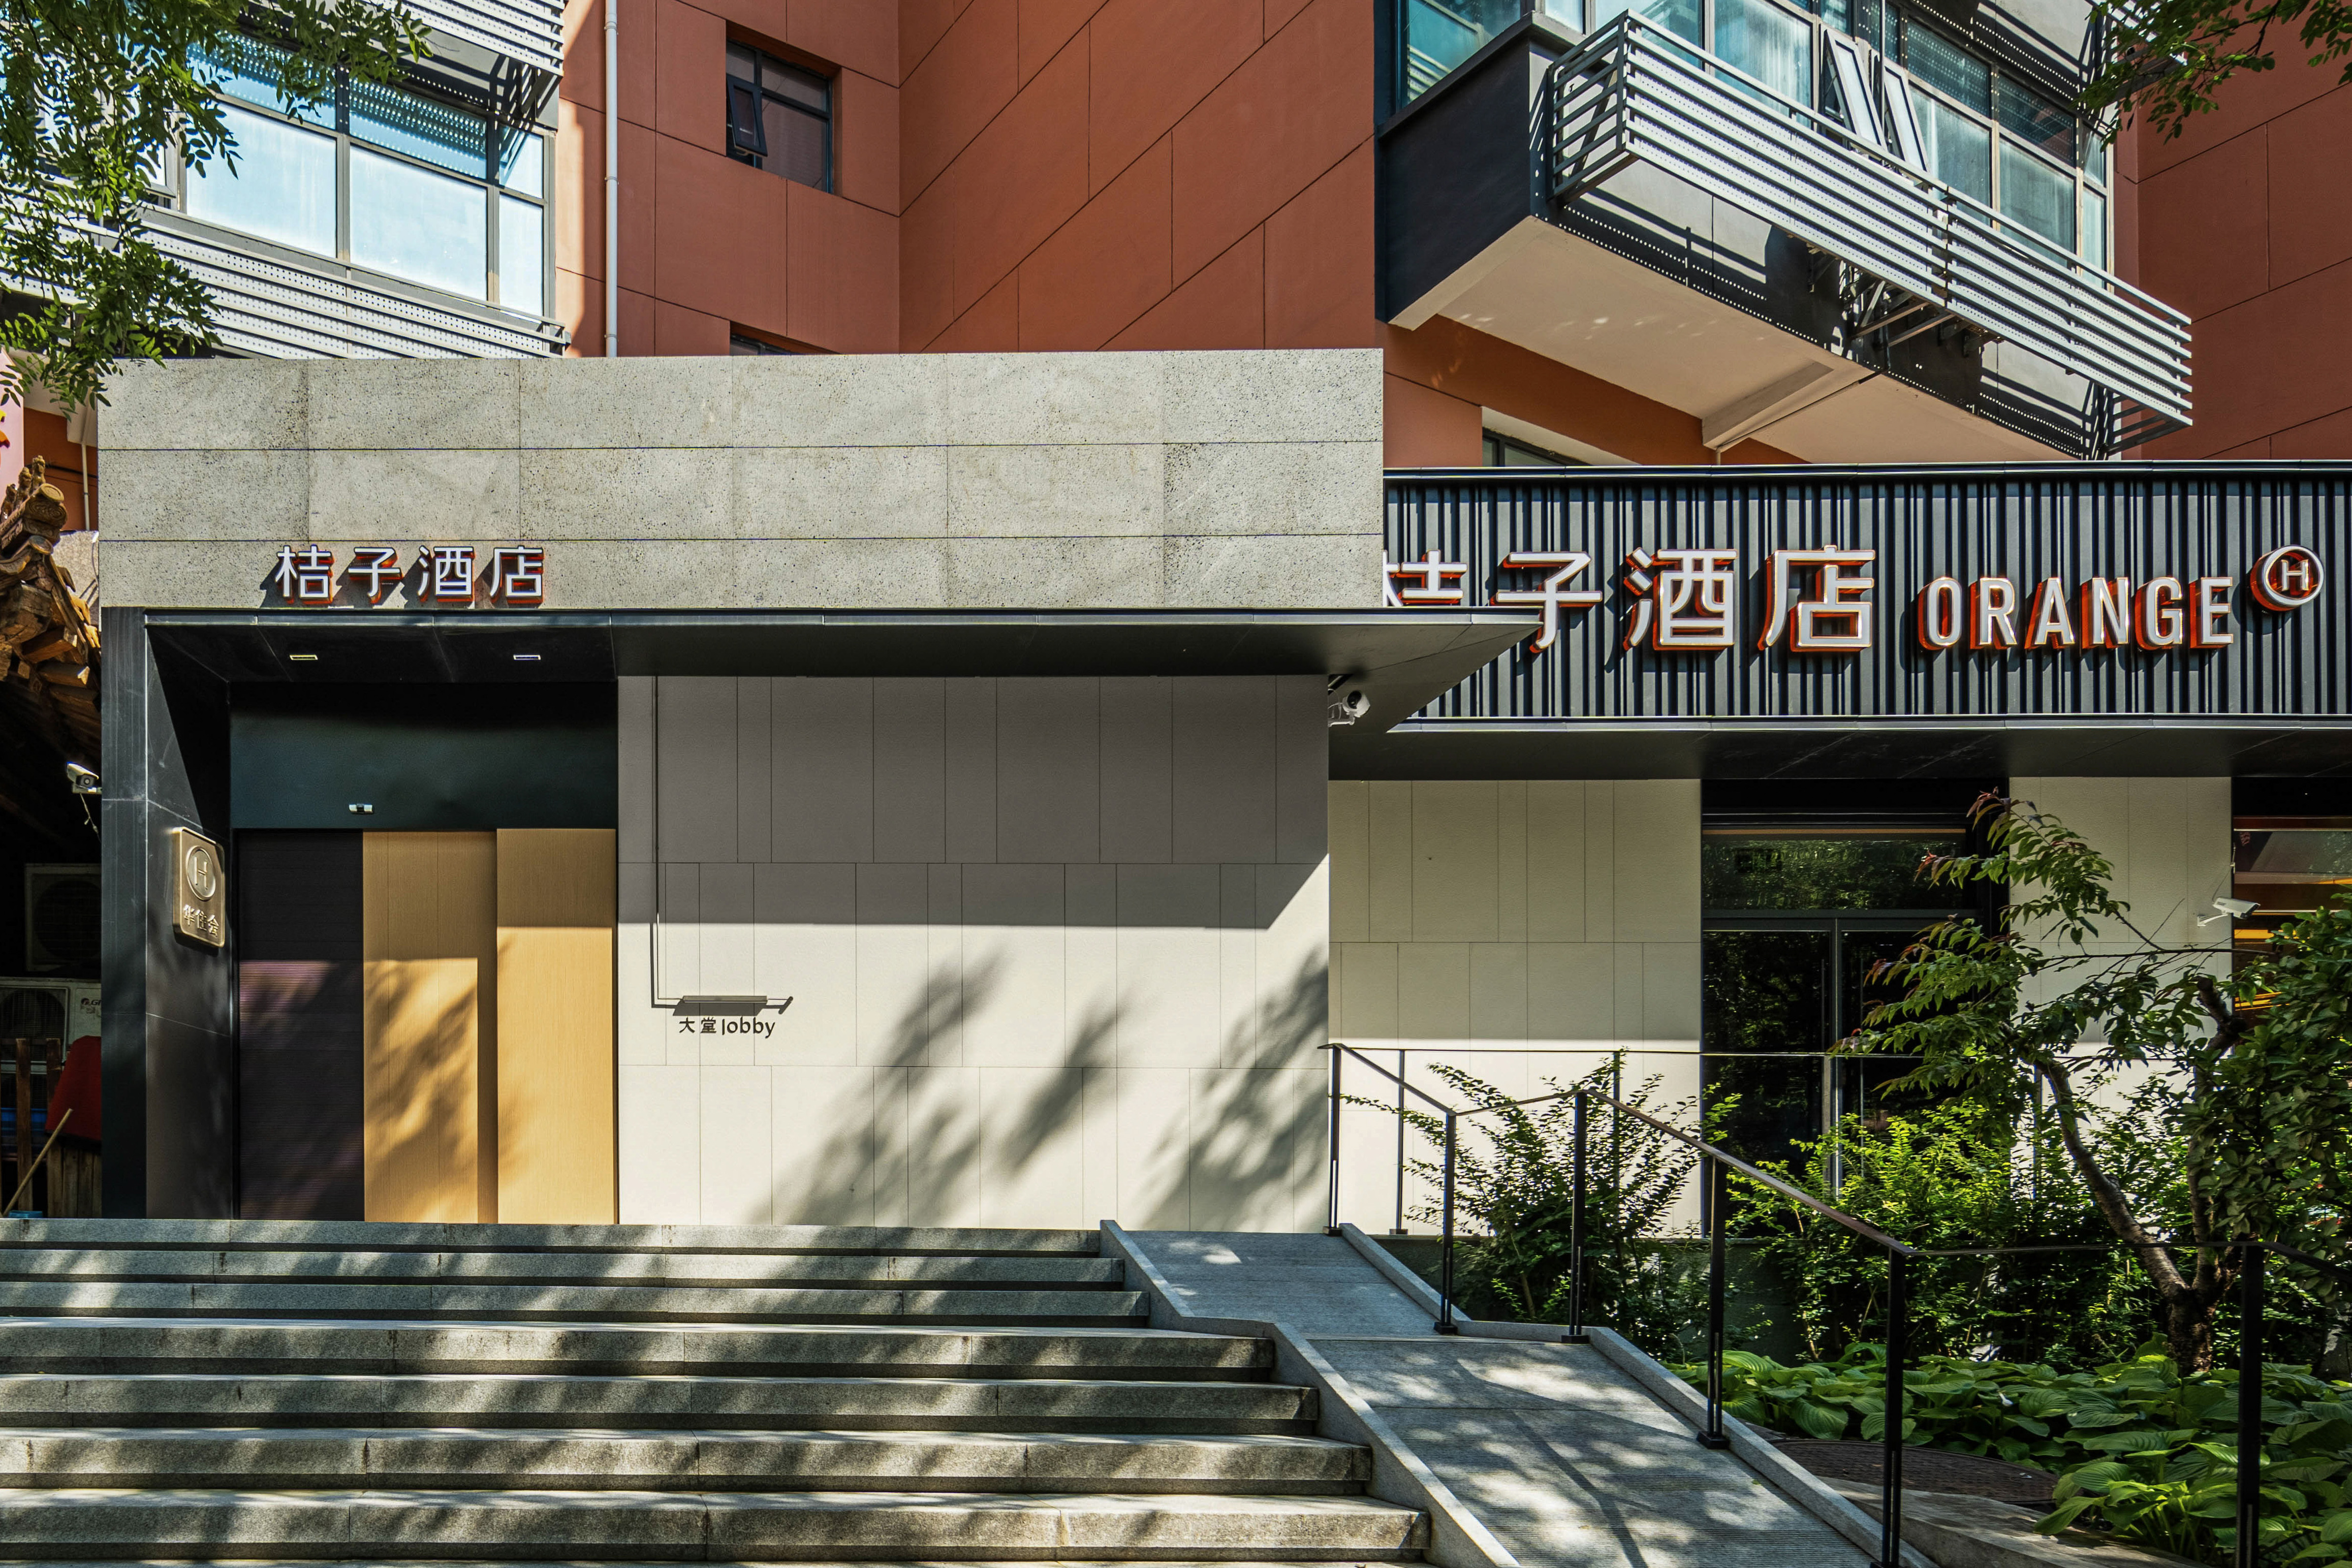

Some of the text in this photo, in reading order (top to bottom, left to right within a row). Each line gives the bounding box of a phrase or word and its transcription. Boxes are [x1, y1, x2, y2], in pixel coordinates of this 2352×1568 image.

[274, 545, 544, 598] 桔子酒店
[1927, 576, 2233, 646] ORANGE
[2281, 559, 2309, 590] H
[194, 857, 208, 890] H
[183, 904, 219, 937] 华住会
[679, 1017, 775, 1039] 大堂 lobby
